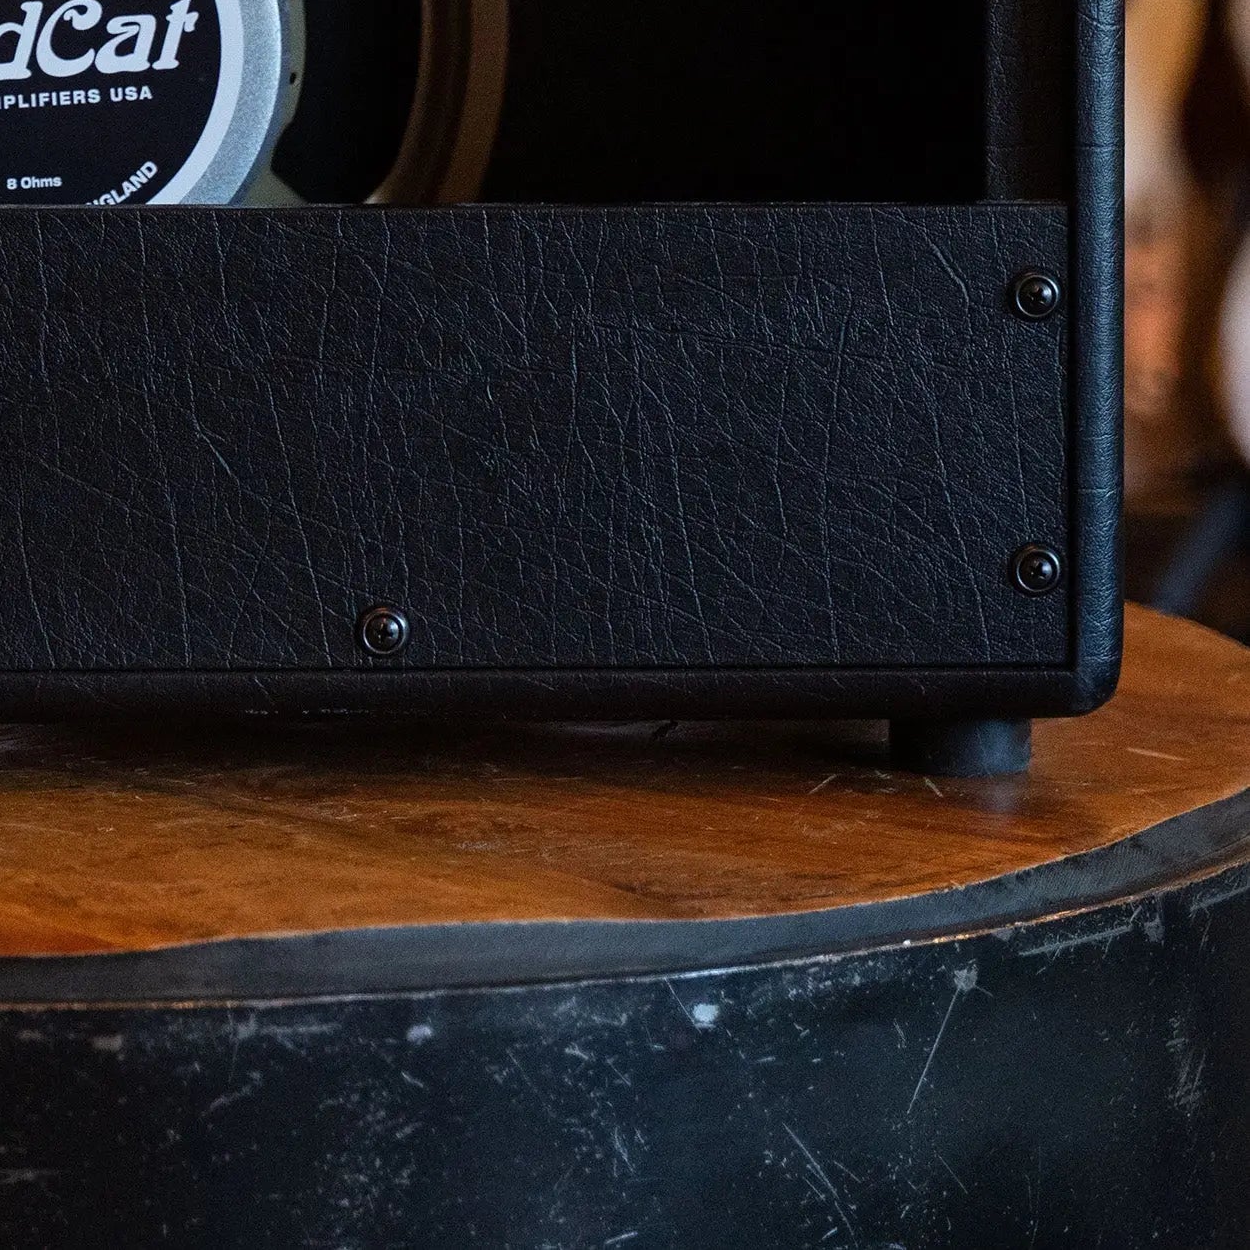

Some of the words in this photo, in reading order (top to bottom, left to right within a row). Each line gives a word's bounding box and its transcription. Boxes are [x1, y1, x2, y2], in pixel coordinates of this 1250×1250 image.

[110, 86, 152, 102] USA
[6, 178, 15, 190] 8
[20, 176, 62, 189] Ohms
[85, 161, 158, 205] GLAND
